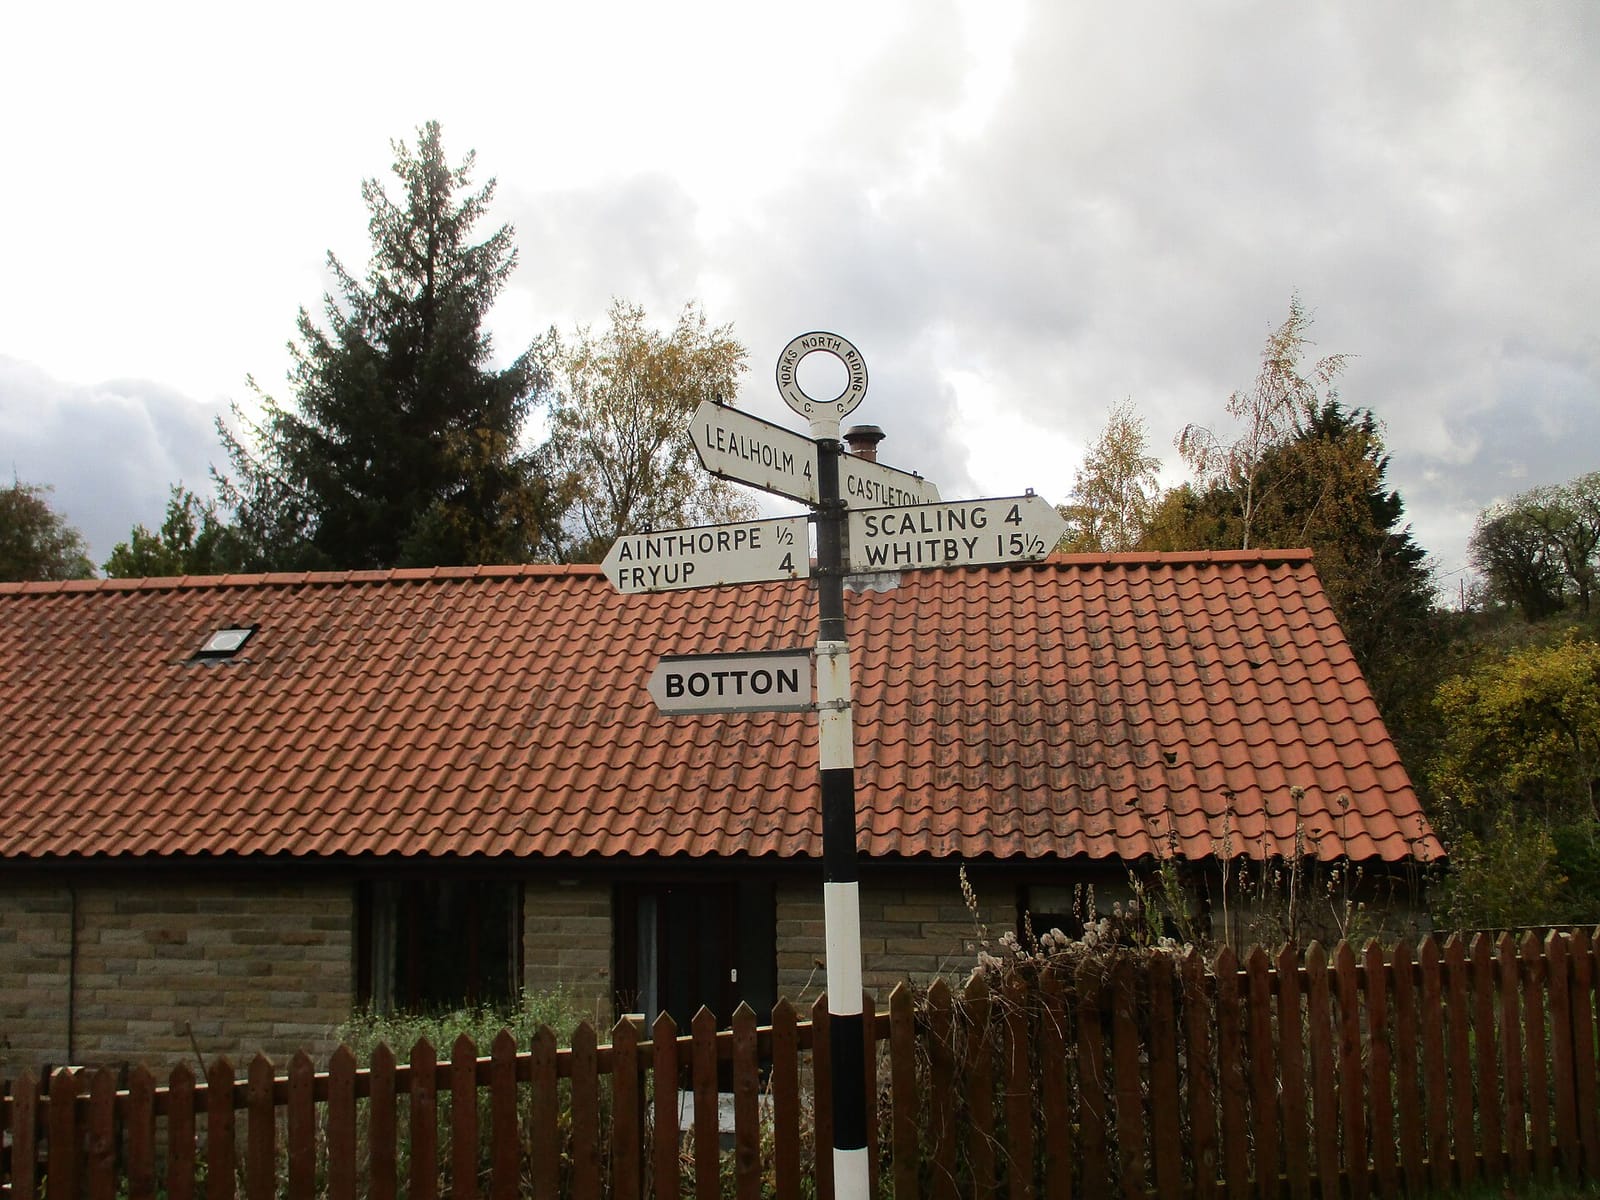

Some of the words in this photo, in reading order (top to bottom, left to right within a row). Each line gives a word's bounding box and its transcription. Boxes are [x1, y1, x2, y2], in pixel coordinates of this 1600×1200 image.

[781, 349, 798, 388] YORKS
[801, 336, 842, 352] NORTH
[845, 350, 864, 392] RIDING
[705, 423, 795, 476] LEALHOLM
[802, 460, 812, 482] 4
[865, 506, 988, 538] SCALING
[1005, 504, 1023, 527] 4
[618, 527, 762, 562] AINTHORPE
[865, 536, 981, 566] WHITBY
[618, 562, 695, 590] FRYUP
[779, 552, 795, 574] 4
[666, 668, 799, 698] BOTTON
